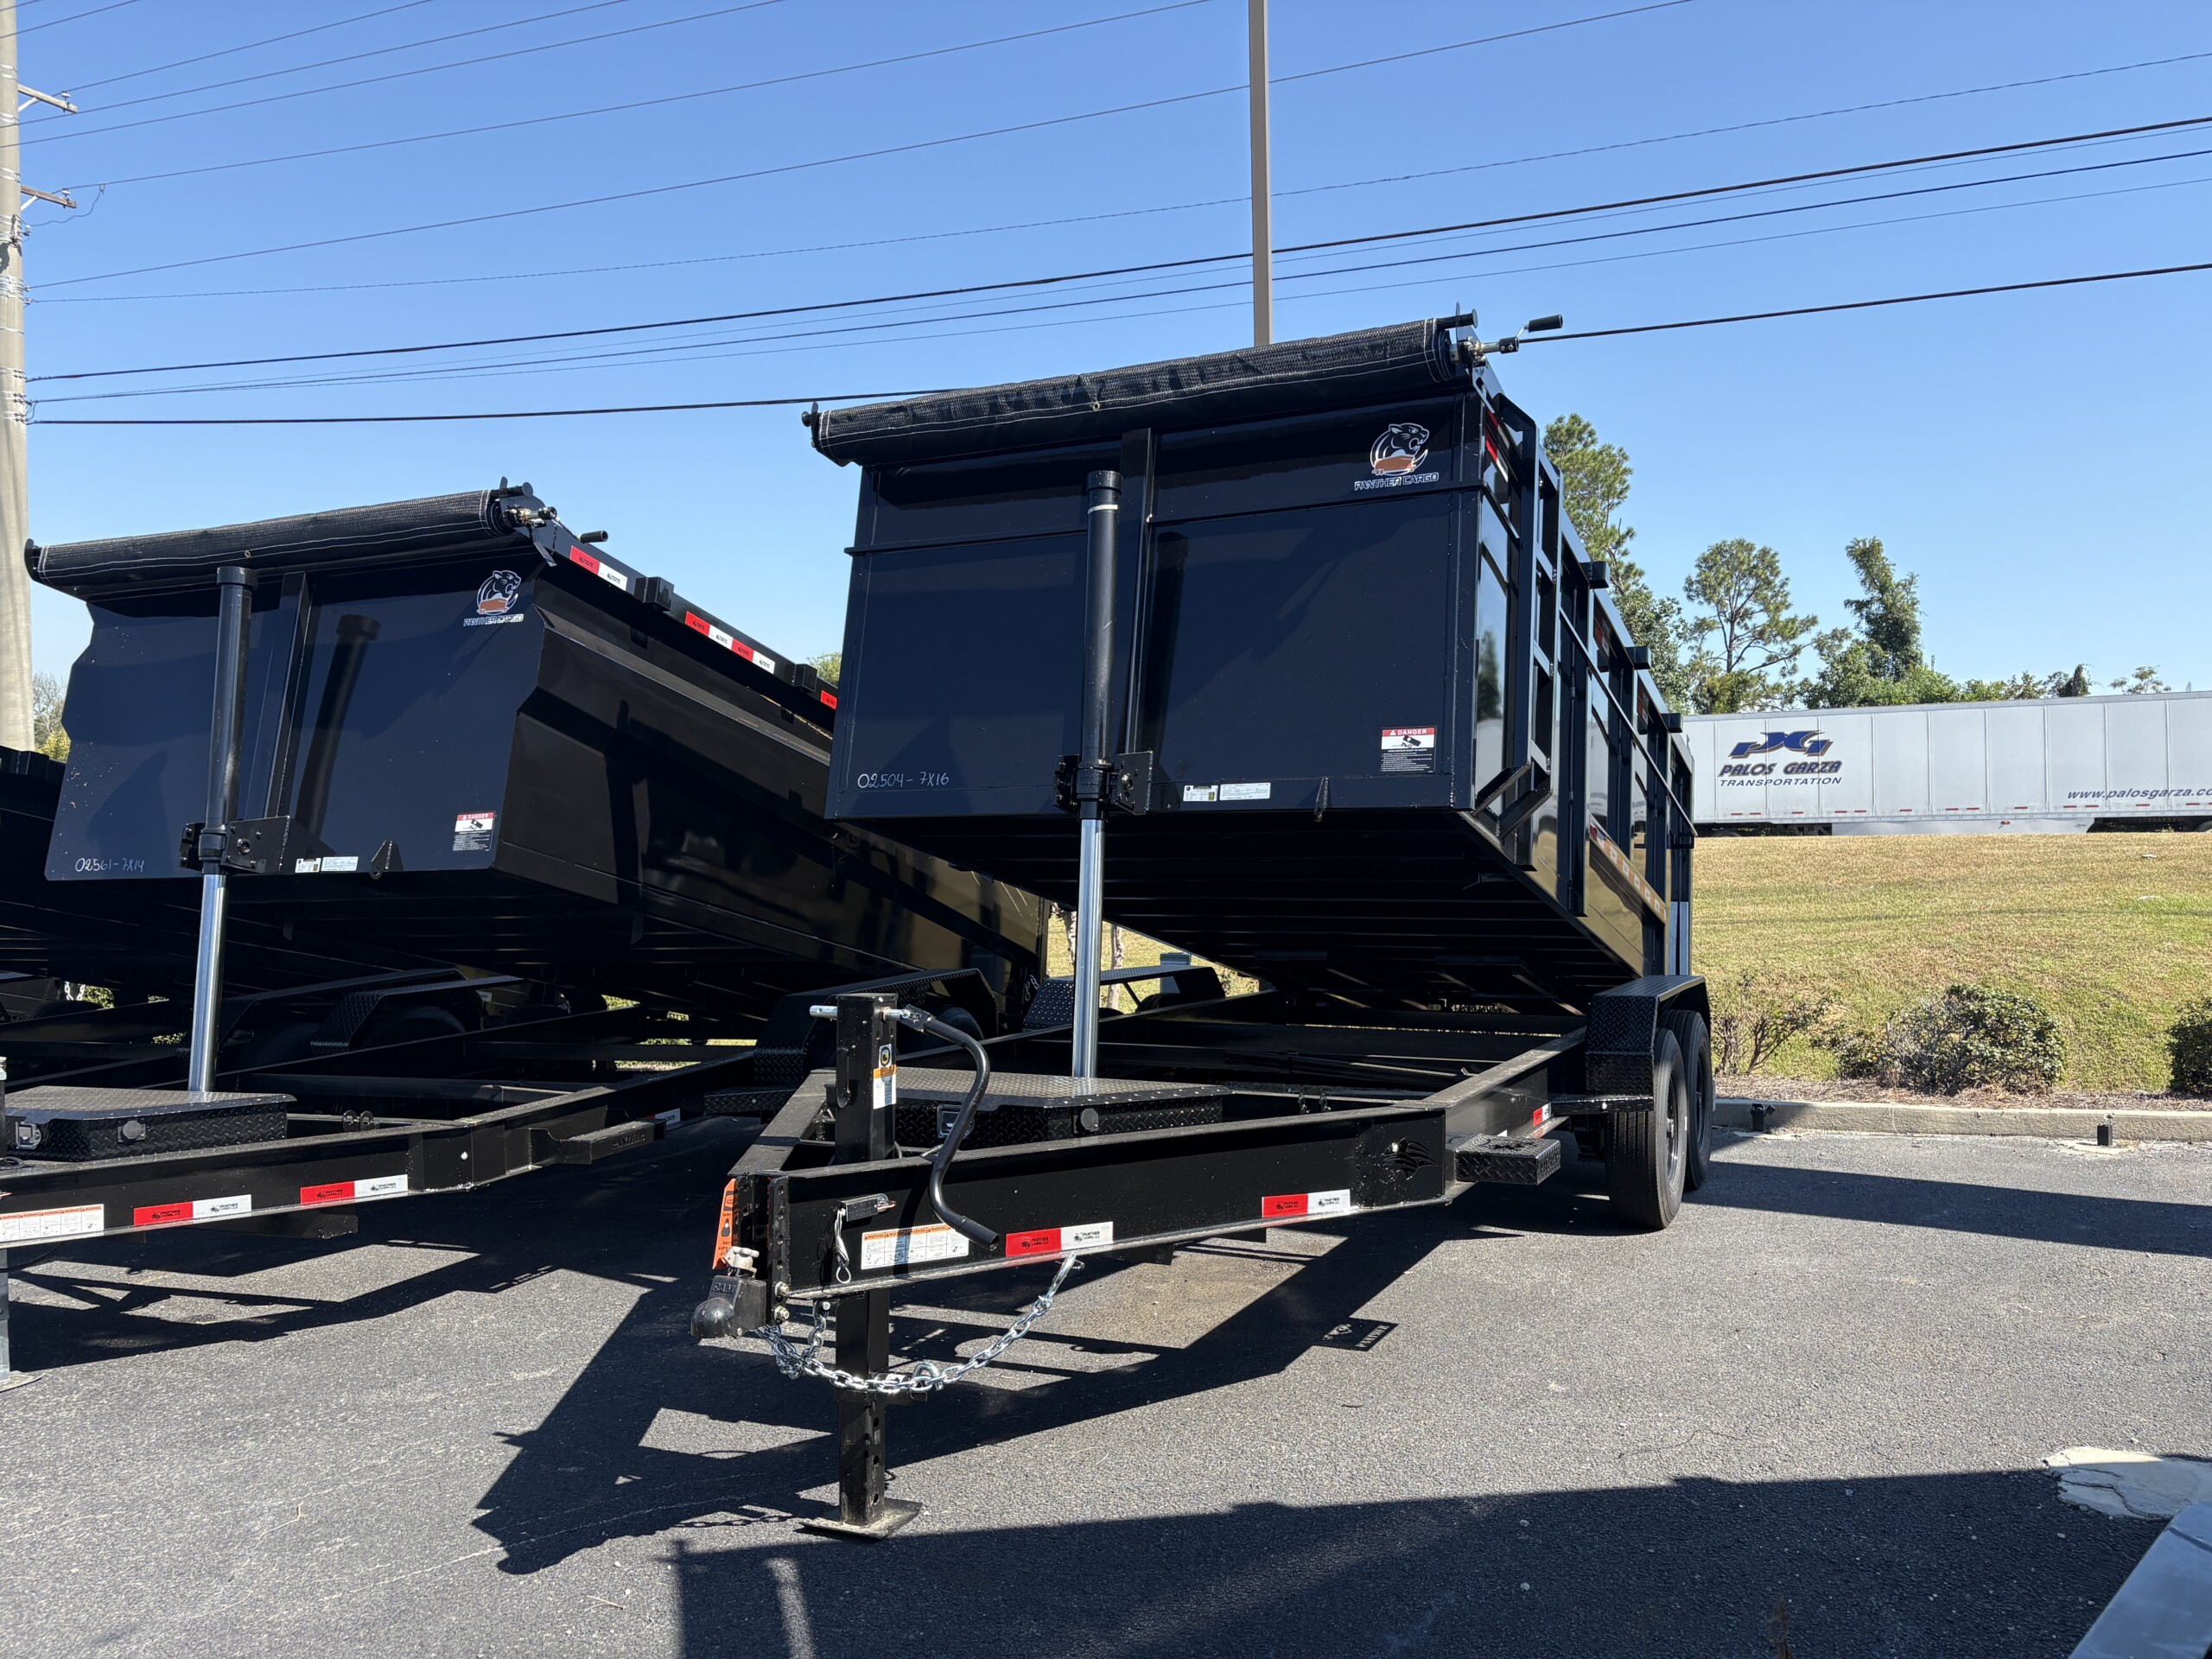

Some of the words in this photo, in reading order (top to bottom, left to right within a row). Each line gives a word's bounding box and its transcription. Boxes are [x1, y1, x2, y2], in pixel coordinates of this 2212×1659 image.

[1354, 476, 1402, 491] PANTHER
[1403, 472, 1440, 485] CARGO
[463, 616, 498, 627] PANTHER
[498, 613, 524, 624] CARGO
[1718, 762, 1777, 777] PALOS
[1783, 760, 1842, 775] GARZA
[1720, 777, 1842, 787] TRANSPORTATION
